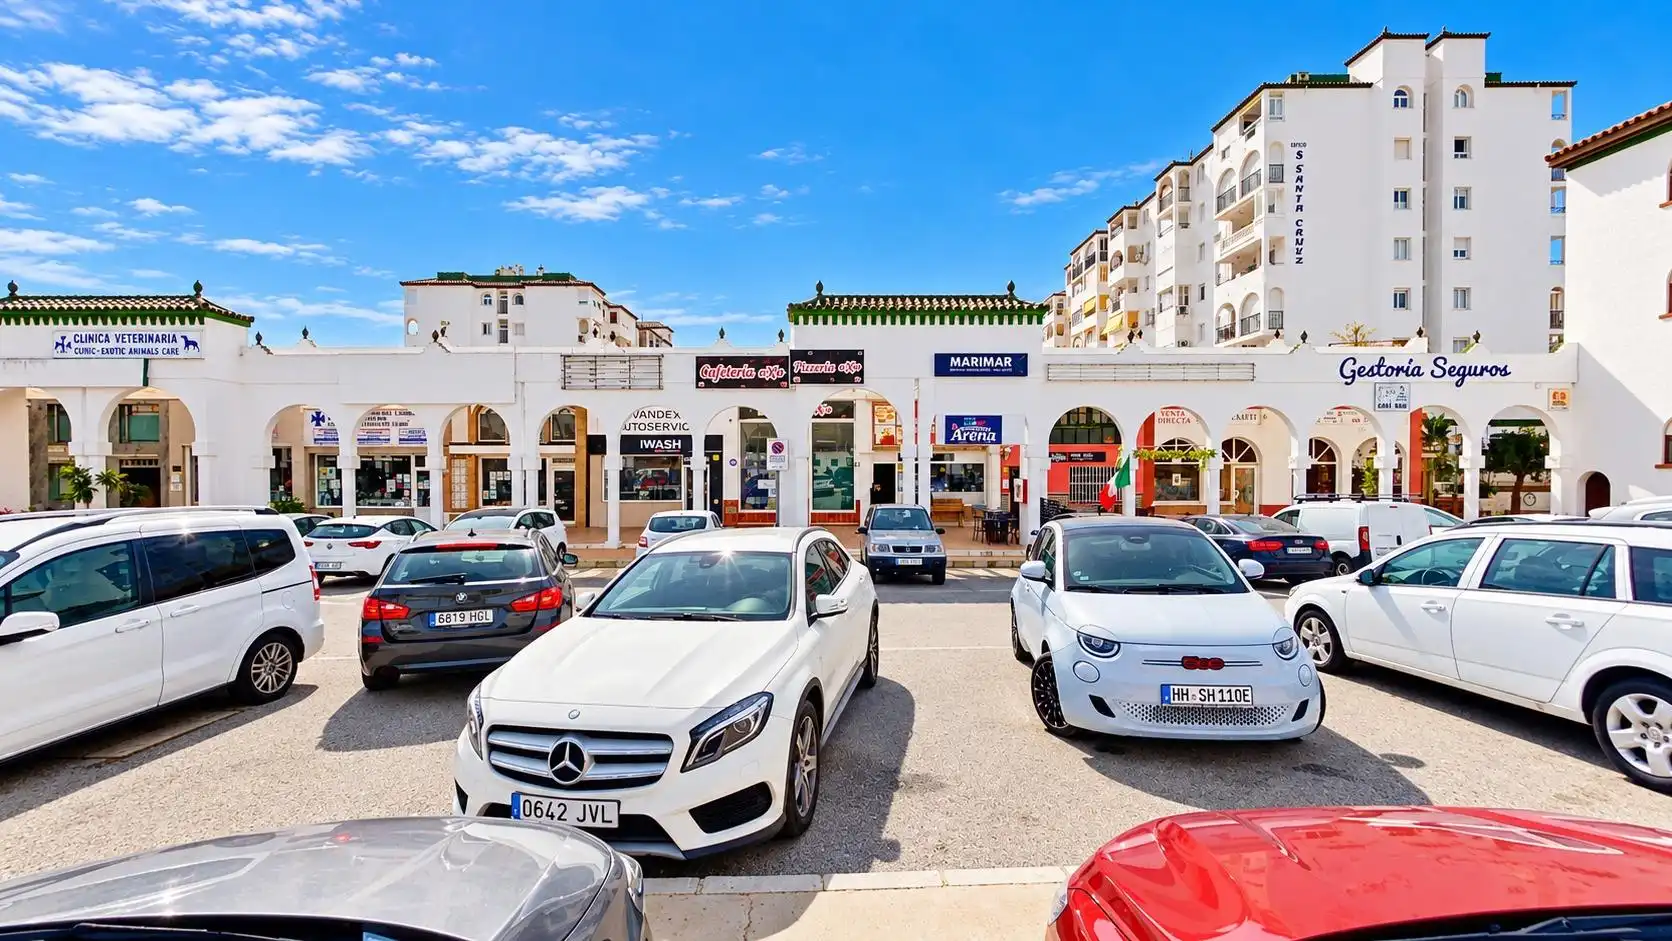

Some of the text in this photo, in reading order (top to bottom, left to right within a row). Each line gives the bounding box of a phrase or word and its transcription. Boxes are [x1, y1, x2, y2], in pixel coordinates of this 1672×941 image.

[74, 334, 178, 344] CLINICA VETERINARIA
[161, 347, 180, 355] CARE
[950, 356, 1012, 367] MARIMAR
[1430, 356, 1511, 387] Seguros
[950, 428, 996, 443] Arena
[640, 440, 681, 449] IWASH
[438, 610, 490, 624] 6819 HGL
[522, 799, 613, 824] 0642 JVL
